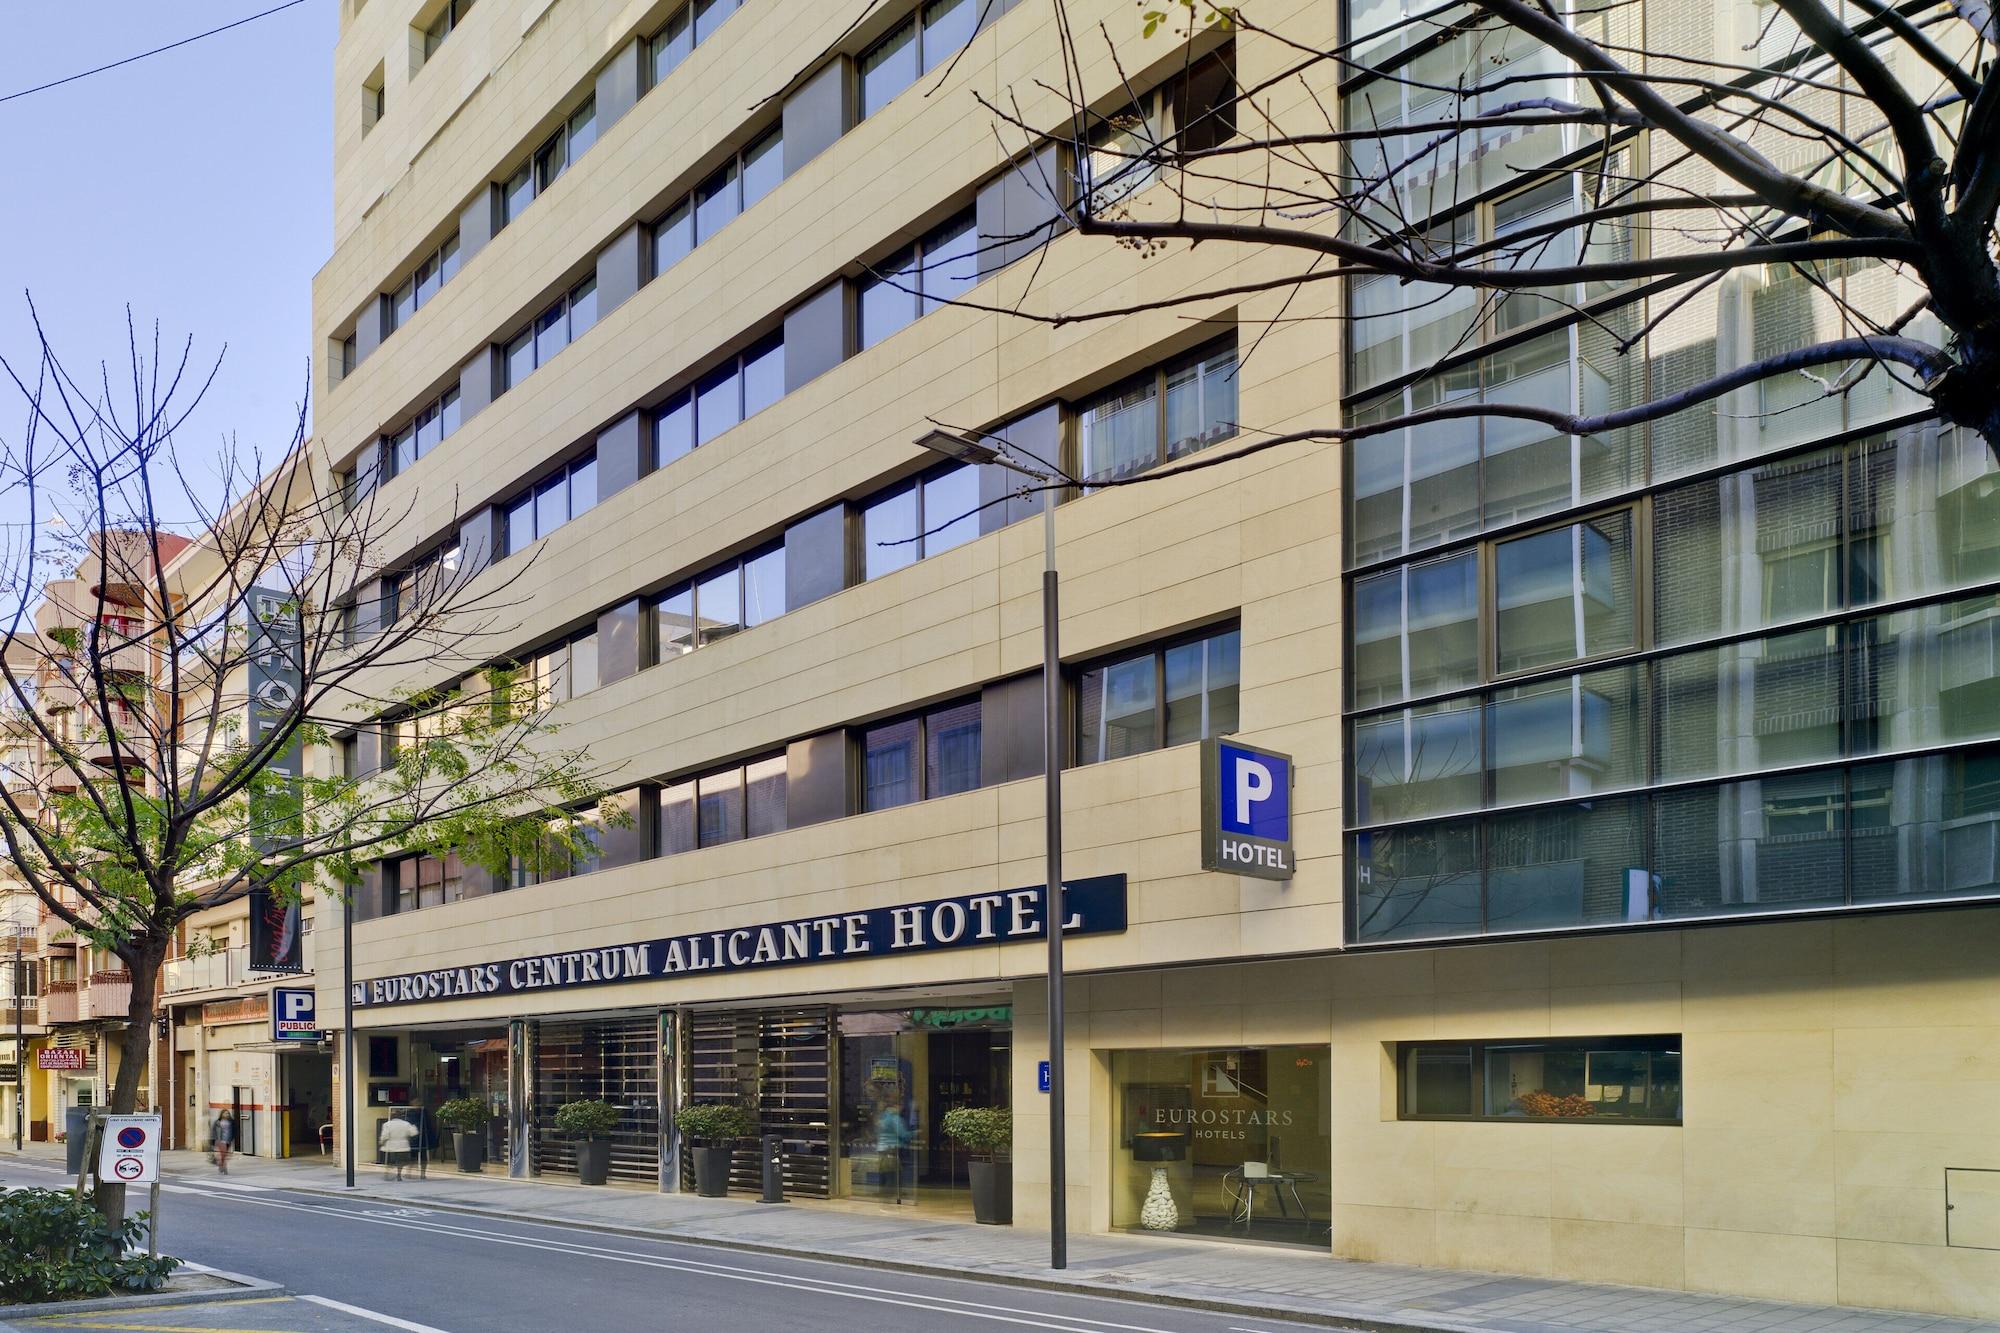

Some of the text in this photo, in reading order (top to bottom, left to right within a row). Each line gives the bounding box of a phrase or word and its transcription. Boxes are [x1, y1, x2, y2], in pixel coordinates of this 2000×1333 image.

[1236, 757, 1273, 825] P
[1222, 839, 1287, 869] HOTEL
[372, 964, 500, 1004] EUROSTARS
[509, 944, 650, 990] CENTRUM
[662, 914, 870, 973] ALICANTE
[285, 993, 313, 1020] P
[280, 1022, 315, 1030] PUBLIC
[1155, 1108, 1293, 1126] EUROSTARS
[1195, 1130, 1246, 1140] HOTELS
